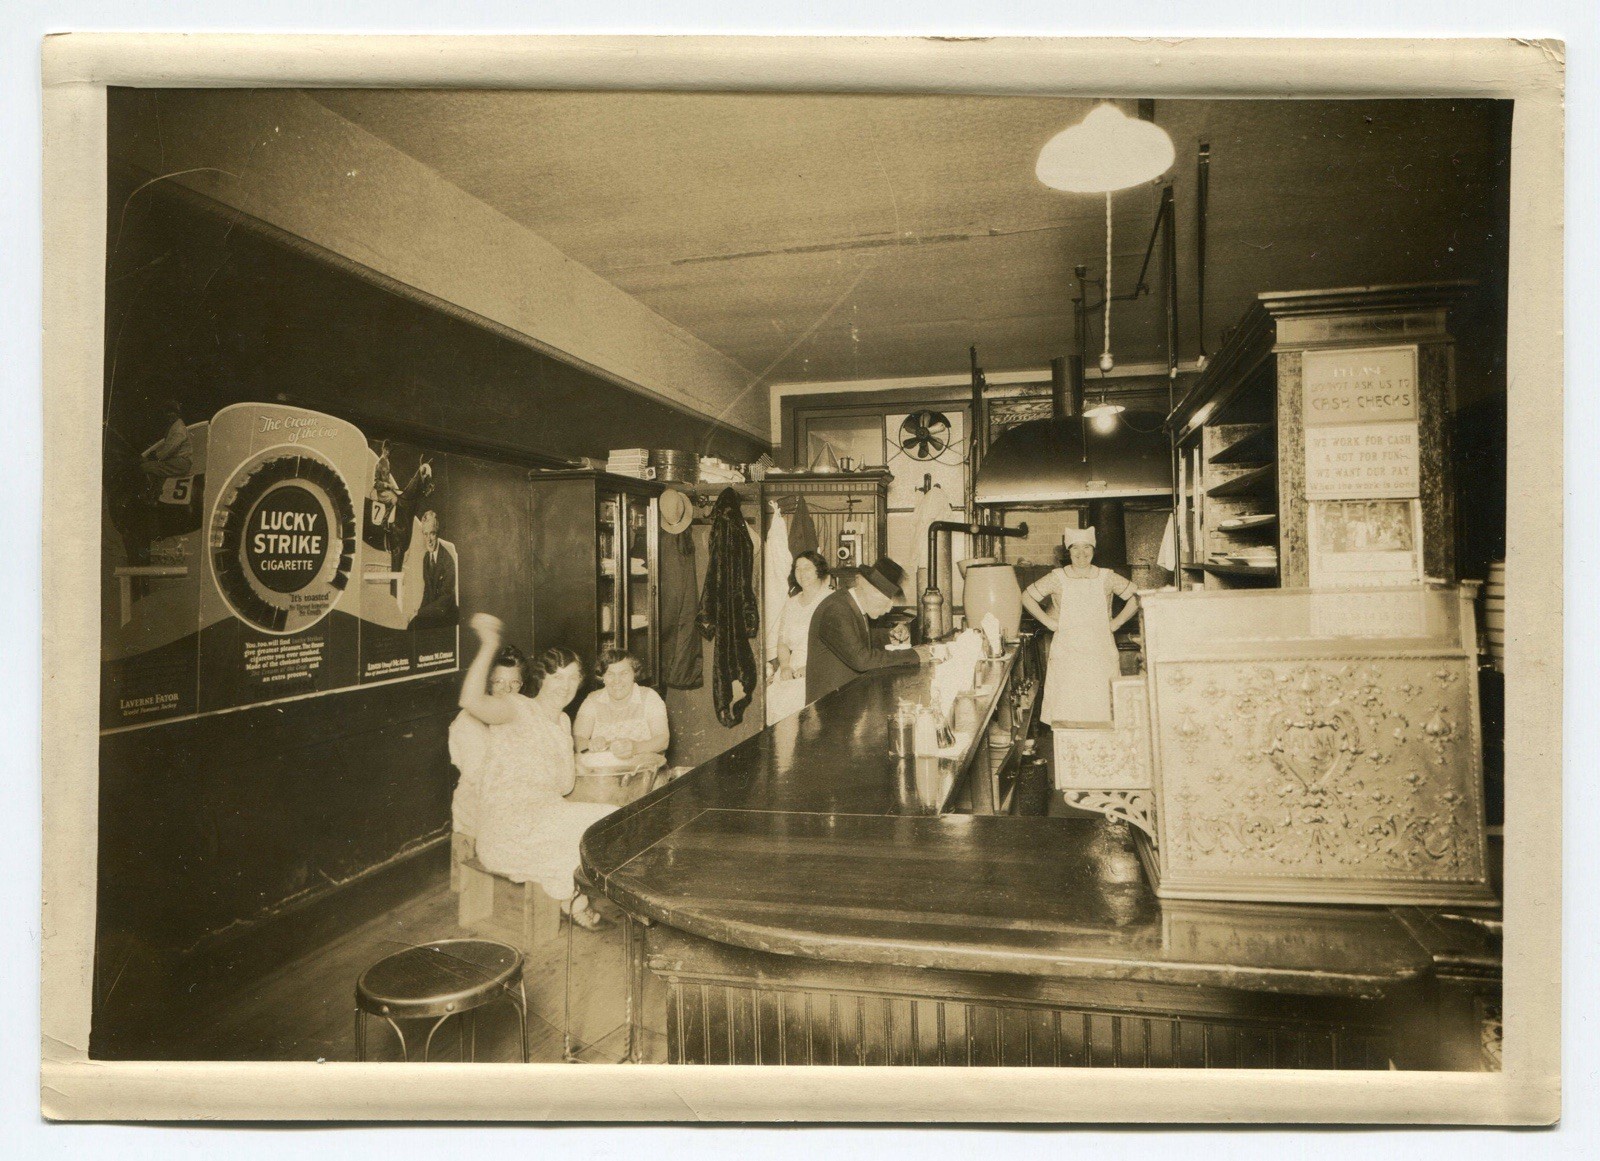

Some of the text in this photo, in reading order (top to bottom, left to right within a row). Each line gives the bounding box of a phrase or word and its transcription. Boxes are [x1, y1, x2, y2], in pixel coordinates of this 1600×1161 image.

[259, 416, 318, 433] The Cream
[288, 426, 338, 443] of the Crop
[1332, 437, 1360, 446] WORK
[1365, 435, 1383, 445] FOR
[1387, 435, 1411, 445] CASH
[1360, 452, 1377, 461] FOR
[1336, 468, 1361, 477] WANT
[1367, 467, 1385, 476] OUR
[1391, 466, 1410, 476] PAY
[173, 479, 190, 500] 5
[374, 505, 381, 520] 7
[261, 511, 318, 532] LUCKY
[254, 533, 322, 554] STRIKE
[261, 560, 314, 571] CIGARETTE
[120, 693, 179, 709] LAVERNE FATOR
